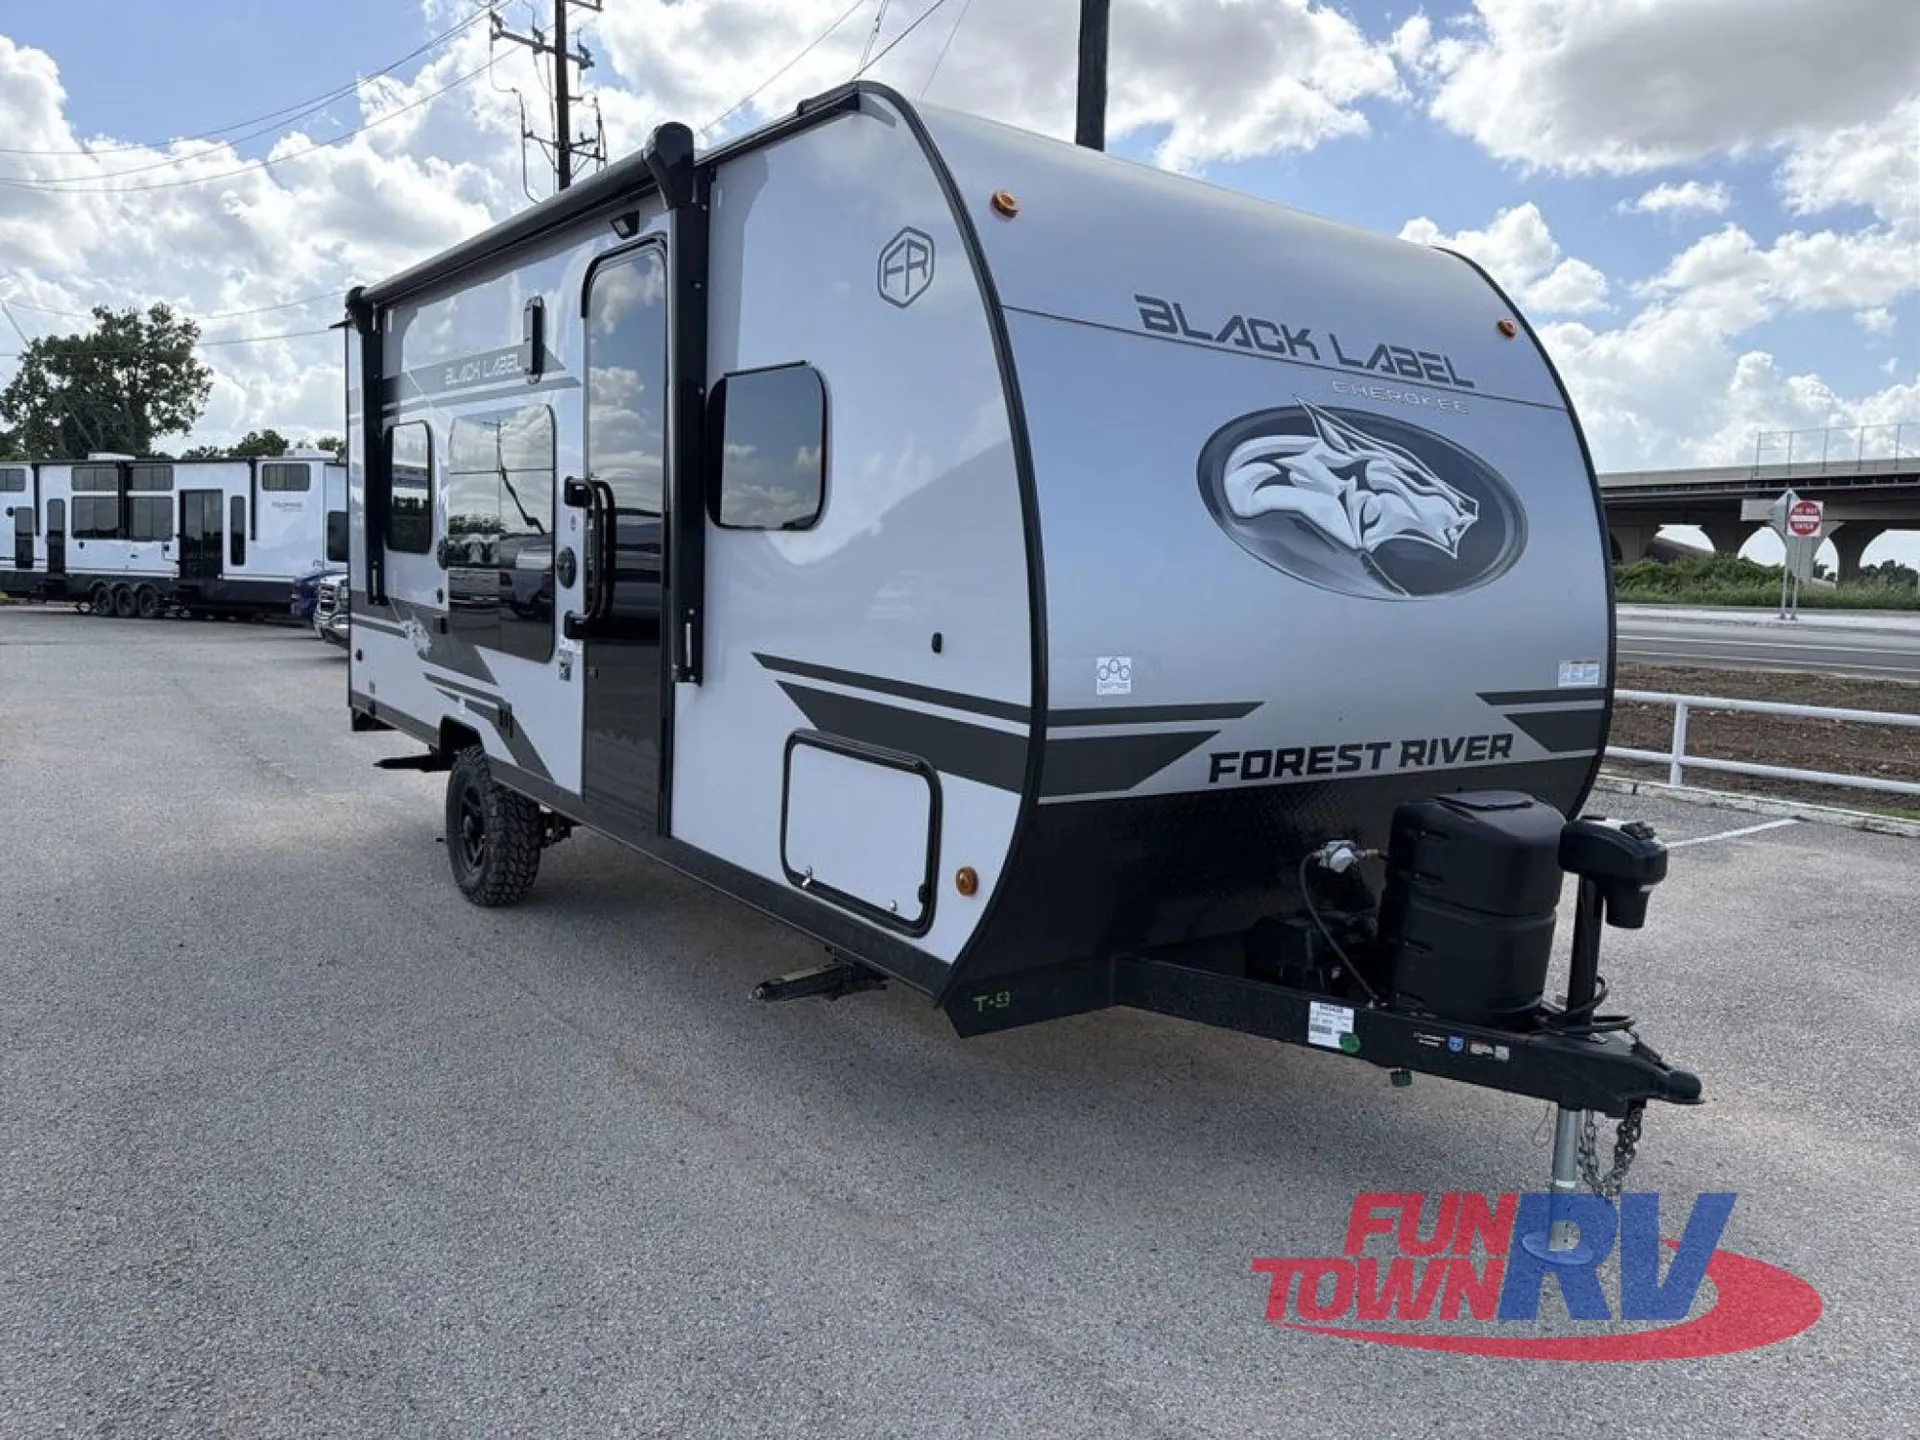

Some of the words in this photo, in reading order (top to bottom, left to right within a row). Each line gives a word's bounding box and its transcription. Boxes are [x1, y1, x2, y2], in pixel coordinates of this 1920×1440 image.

[1134, 294, 1321, 361] BLACK
[1329, 333, 1475, 389] LABEL
[483, 353, 522, 379] LABEL
[1332, 380, 1468, 417] CHEROKEE
[1209, 742, 1392, 783] FOREST
[1399, 733, 1514, 768] RIVER
